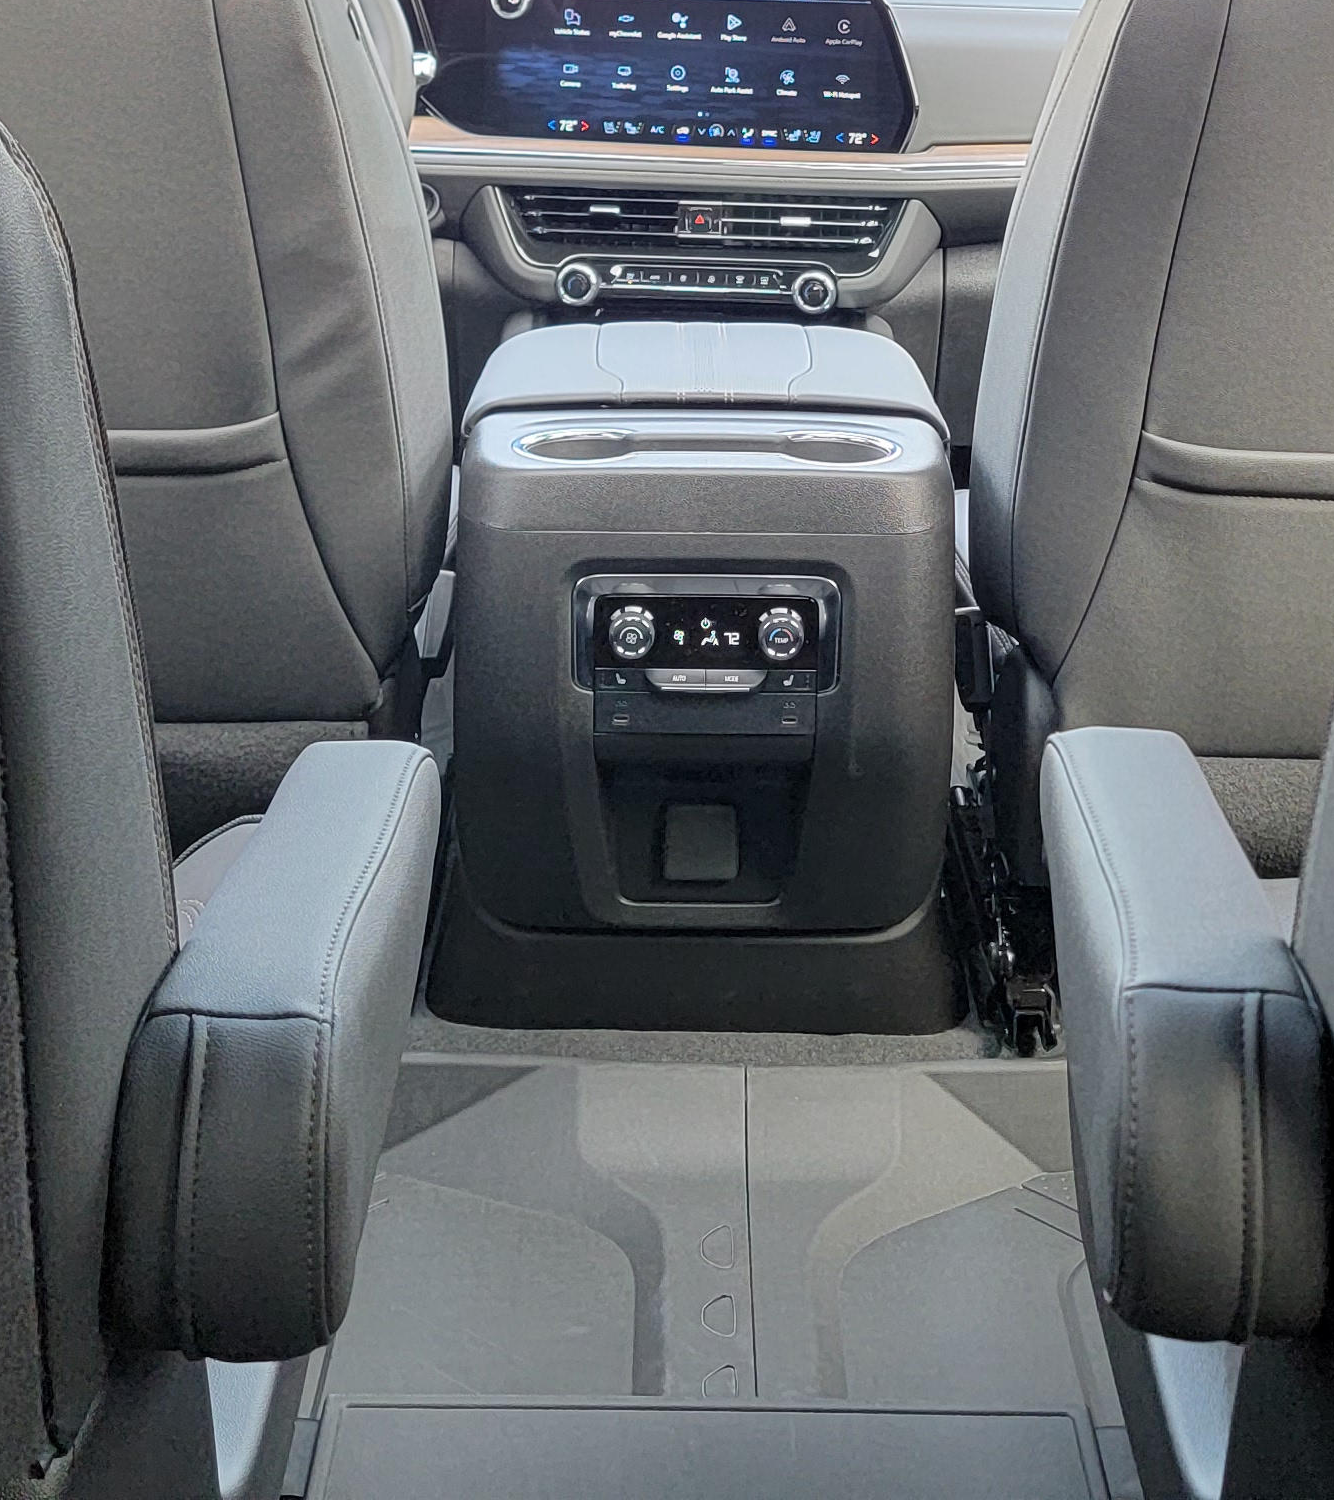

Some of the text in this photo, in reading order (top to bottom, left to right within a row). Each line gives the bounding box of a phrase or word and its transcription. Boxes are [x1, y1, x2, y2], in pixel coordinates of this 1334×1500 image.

[657, 31, 702, 40] Google Assistant
[720, 34, 747, 42] Play Store
[825, 38, 863, 47] Apple CarPlay
[666, 84, 689, 93] Settings
[710, 86, 723, 94] Auto
[736, 87, 754, 95] Assist
[838, 91, 861, 100] Hotspot
[559, 119, 579, 132] 72°
[650, 125, 665, 134] A/C
[848, 132, 867, 145] 72°
[724, 632, 740, 645] 72
[774, 636, 789, 644] TEMP
[672, 674, 687, 682] AUTO
[724, 675, 739, 683] MODE
